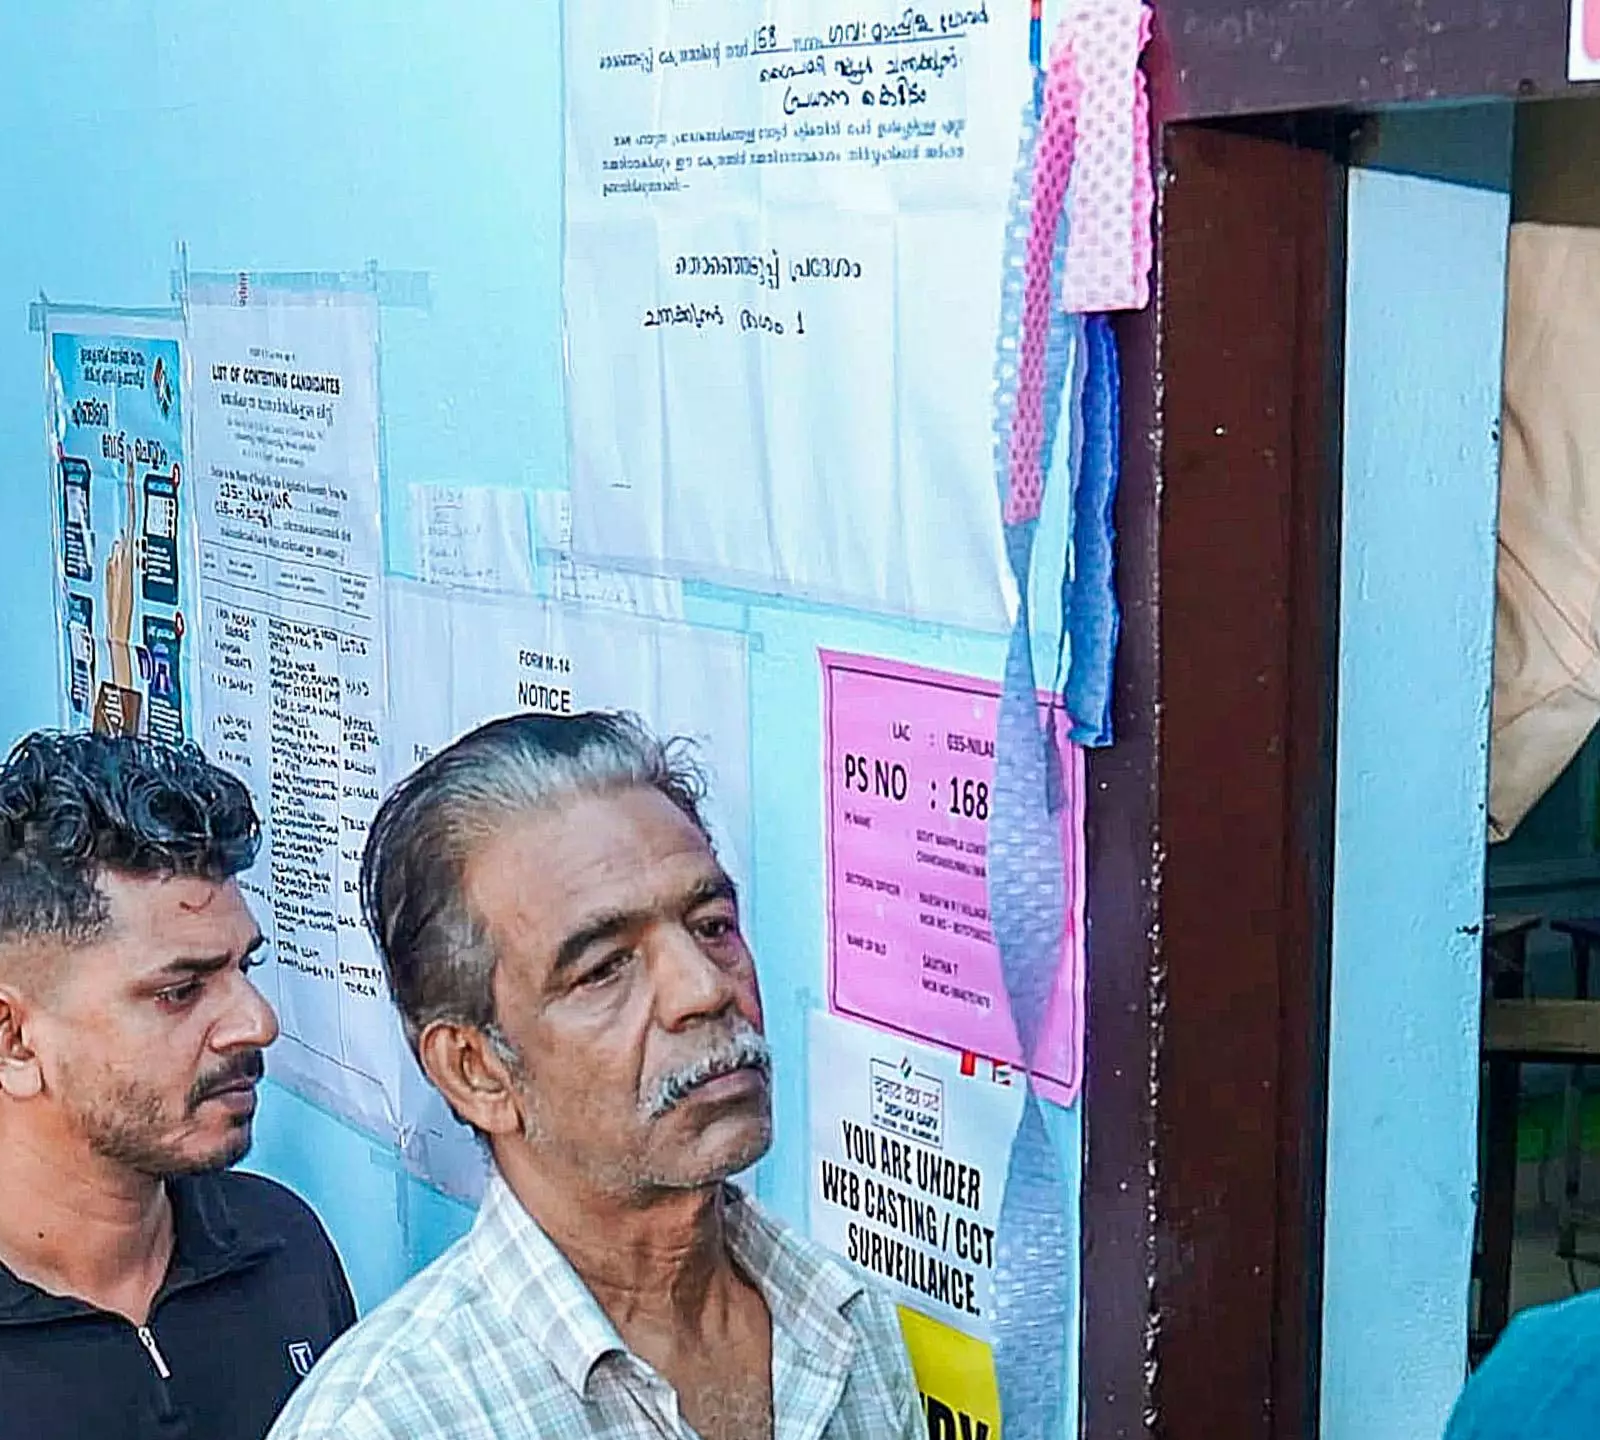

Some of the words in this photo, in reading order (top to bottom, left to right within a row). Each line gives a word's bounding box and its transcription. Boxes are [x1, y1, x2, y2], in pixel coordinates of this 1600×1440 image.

[518, 681, 571, 713] NOTICE
[845, 753, 869, 793] PS
[875, 759, 907, 801] NO
[950, 776, 988, 820] 168
[842, 1119, 876, 1170] YOU
[881, 1136, 913, 1185] ARE
[917, 1149, 980, 1211] UNDER
[822, 1160, 859, 1212] WEB
[864, 1178, 937, 1247] CASTING
[943, 1212, 950, 1252] /
[955, 1217, 995, 1269] CCT
[848, 1222, 981, 1317] SURVEILLANCE.
